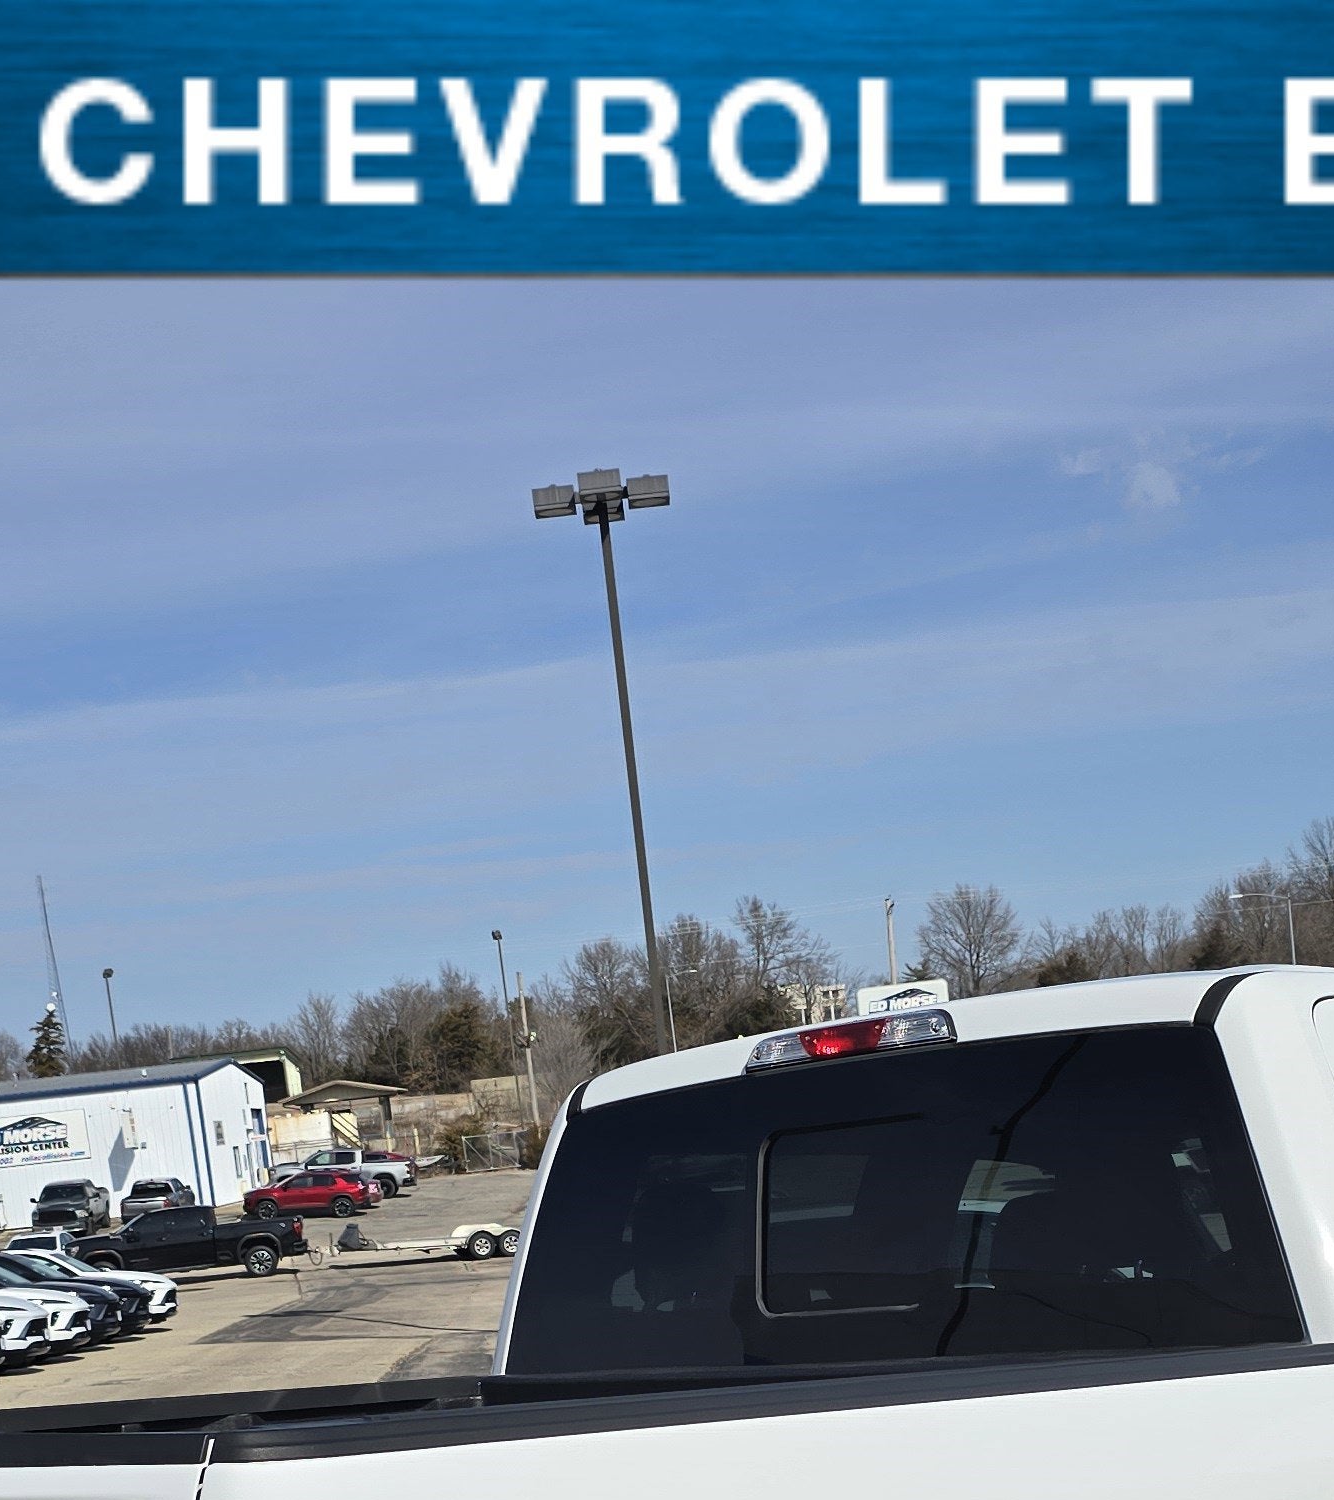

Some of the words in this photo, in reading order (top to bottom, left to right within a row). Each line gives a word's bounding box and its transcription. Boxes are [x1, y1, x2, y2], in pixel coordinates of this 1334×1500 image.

[869, 1001, 888, 1013] ED
[889, 994, 938, 1011] MORSE
[2, 1124, 67, 1146] MORSE
[32, 1140, 70, 1152] CENTER
